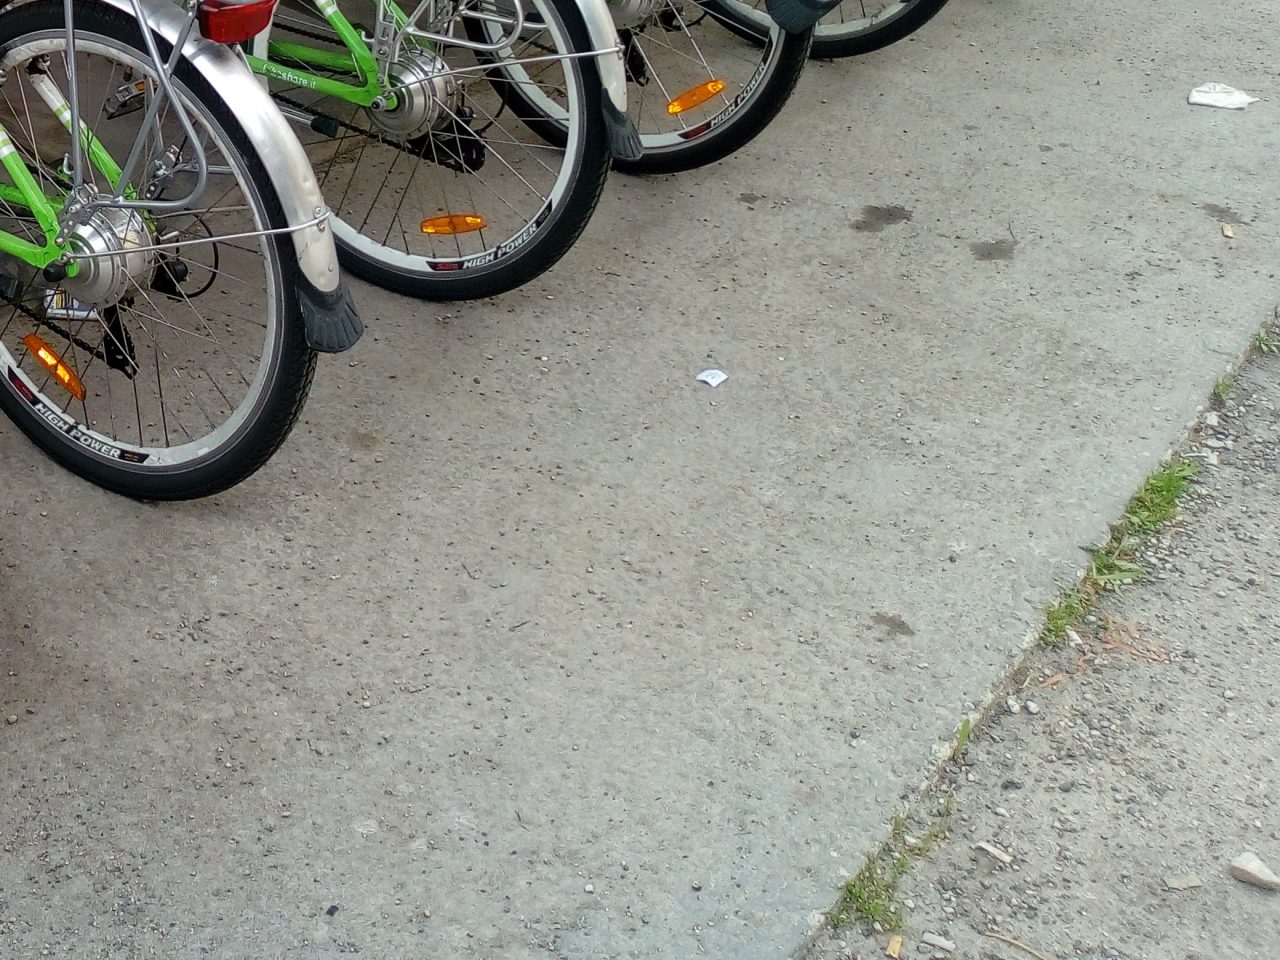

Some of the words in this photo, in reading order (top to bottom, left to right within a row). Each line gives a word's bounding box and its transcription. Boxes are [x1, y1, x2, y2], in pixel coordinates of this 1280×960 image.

[709, 103, 736, 128] HIGH
[737, 62, 768, 105] POWER
[463, 251, 495, 269] HIGH
[497, 223, 538, 258] POWER
[34, 402, 70, 431] HIGH
[69, 428, 122, 459] POWER
